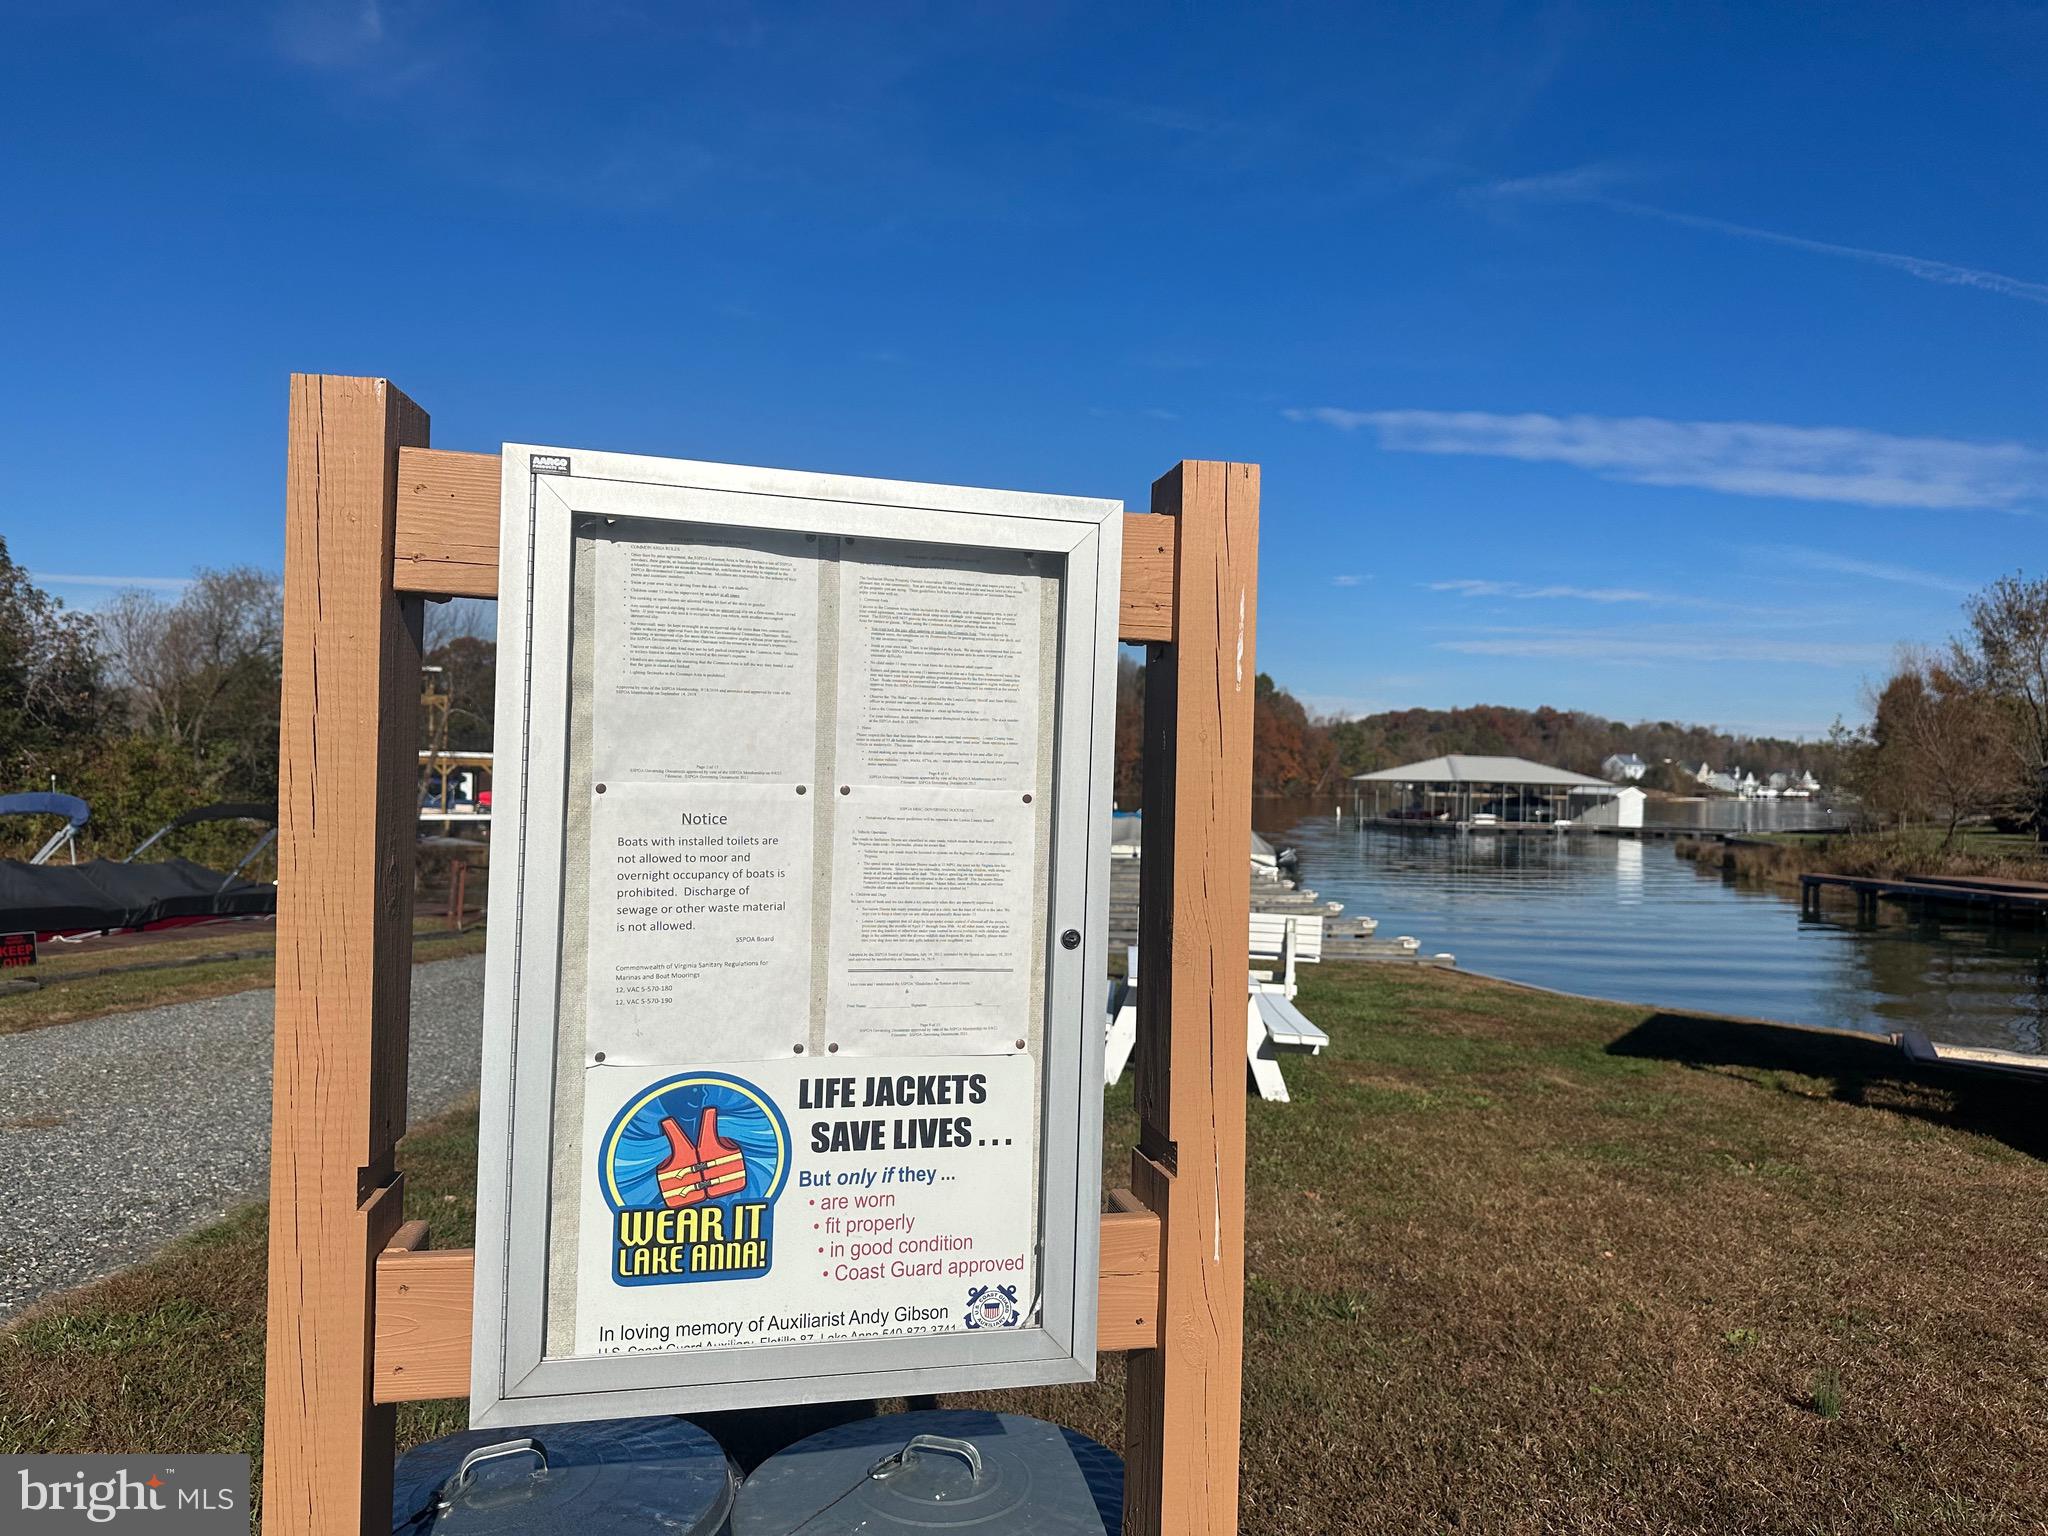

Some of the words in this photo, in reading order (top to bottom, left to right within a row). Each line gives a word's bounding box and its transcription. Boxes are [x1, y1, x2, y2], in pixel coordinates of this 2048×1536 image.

[682, 812, 728, 825] Notice
[618, 837, 648, 847] Boats
[652, 836, 675, 846] with
[678, 836, 724, 846] installed
[726, 836, 759, 846] toilets
[762, 838, 779, 846] are
[617, 854, 635, 864] not
[639, 853, 682, 863] allowed
[685, 854, 697, 863] to
[700, 854, 728, 862] moor
[731, 853, 751, 862] and
[617, 870, 670, 882] overnight
[673, 870, 730, 881] occupancy
[732, 869, 743, 879] of
[746, 868, 775, 879] boats
[778, 869, 786, 878] is
[617, 887, 678, 900] prohibited.
[684, 886, 736, 897] Discharge
[738, 885, 750, 896] of
[617, 905, 658, 916] sewage
[661, 906, 673, 914] or
[676, 904, 705, 914] other
[708, 904, 740, 913] waste
[742, 901, 786, 912] material
[616, 922, 625, 932] is
[628, 922, 646, 932] not
[650, 920, 696, 931] allowed.
[0, 944, 34, 958] KEEP
[616, 964, 665, 972] Commonwealth
[799, 1078, 856, 1109] LIFE
[863, 1074, 986, 1107] JACKETS
[811, 1120, 885, 1153] SAVE
[893, 1117, 972, 1150] LIVES
[799, 1170, 831, 1187] But
[837, 1168, 877, 1189] only
[882, 1166, 896, 1183] if
[898, 1166, 936, 1185] they
[821, 1197, 848, 1210] are
[855, 1194, 896, 1208] worn
[620, 1207, 724, 1247] WEAR
[734, 1204, 766, 1240] IT
[825, 1217, 840, 1234] fit
[846, 1214, 916, 1237] properly
[830, 1241, 844, 1258] in
[850, 1238, 892, 1260] good
[898, 1235, 973, 1254] condition
[620, 1246, 683, 1276] LAKE
[835, 1263, 886, 1281] Coast
[890, 1259, 942, 1278] Guard
[948, 1254, 1024, 1278] approved
[979, 1293, 998, 1302] COAST
[998, 1295, 1009, 1314] GUARD
[599, 1326, 614, 1342] In
[620, 1323, 670, 1342] loving
[676, 1321, 743, 1338] memory
[748, 1316, 765, 1333] of
[767, 1312, 845, 1330] Auxiliarist
[849, 1308, 889, 1326] Andy
[894, 1306, 949, 1322] Gibson
[977, 1316, 1006, 1327] AUXILIARY
